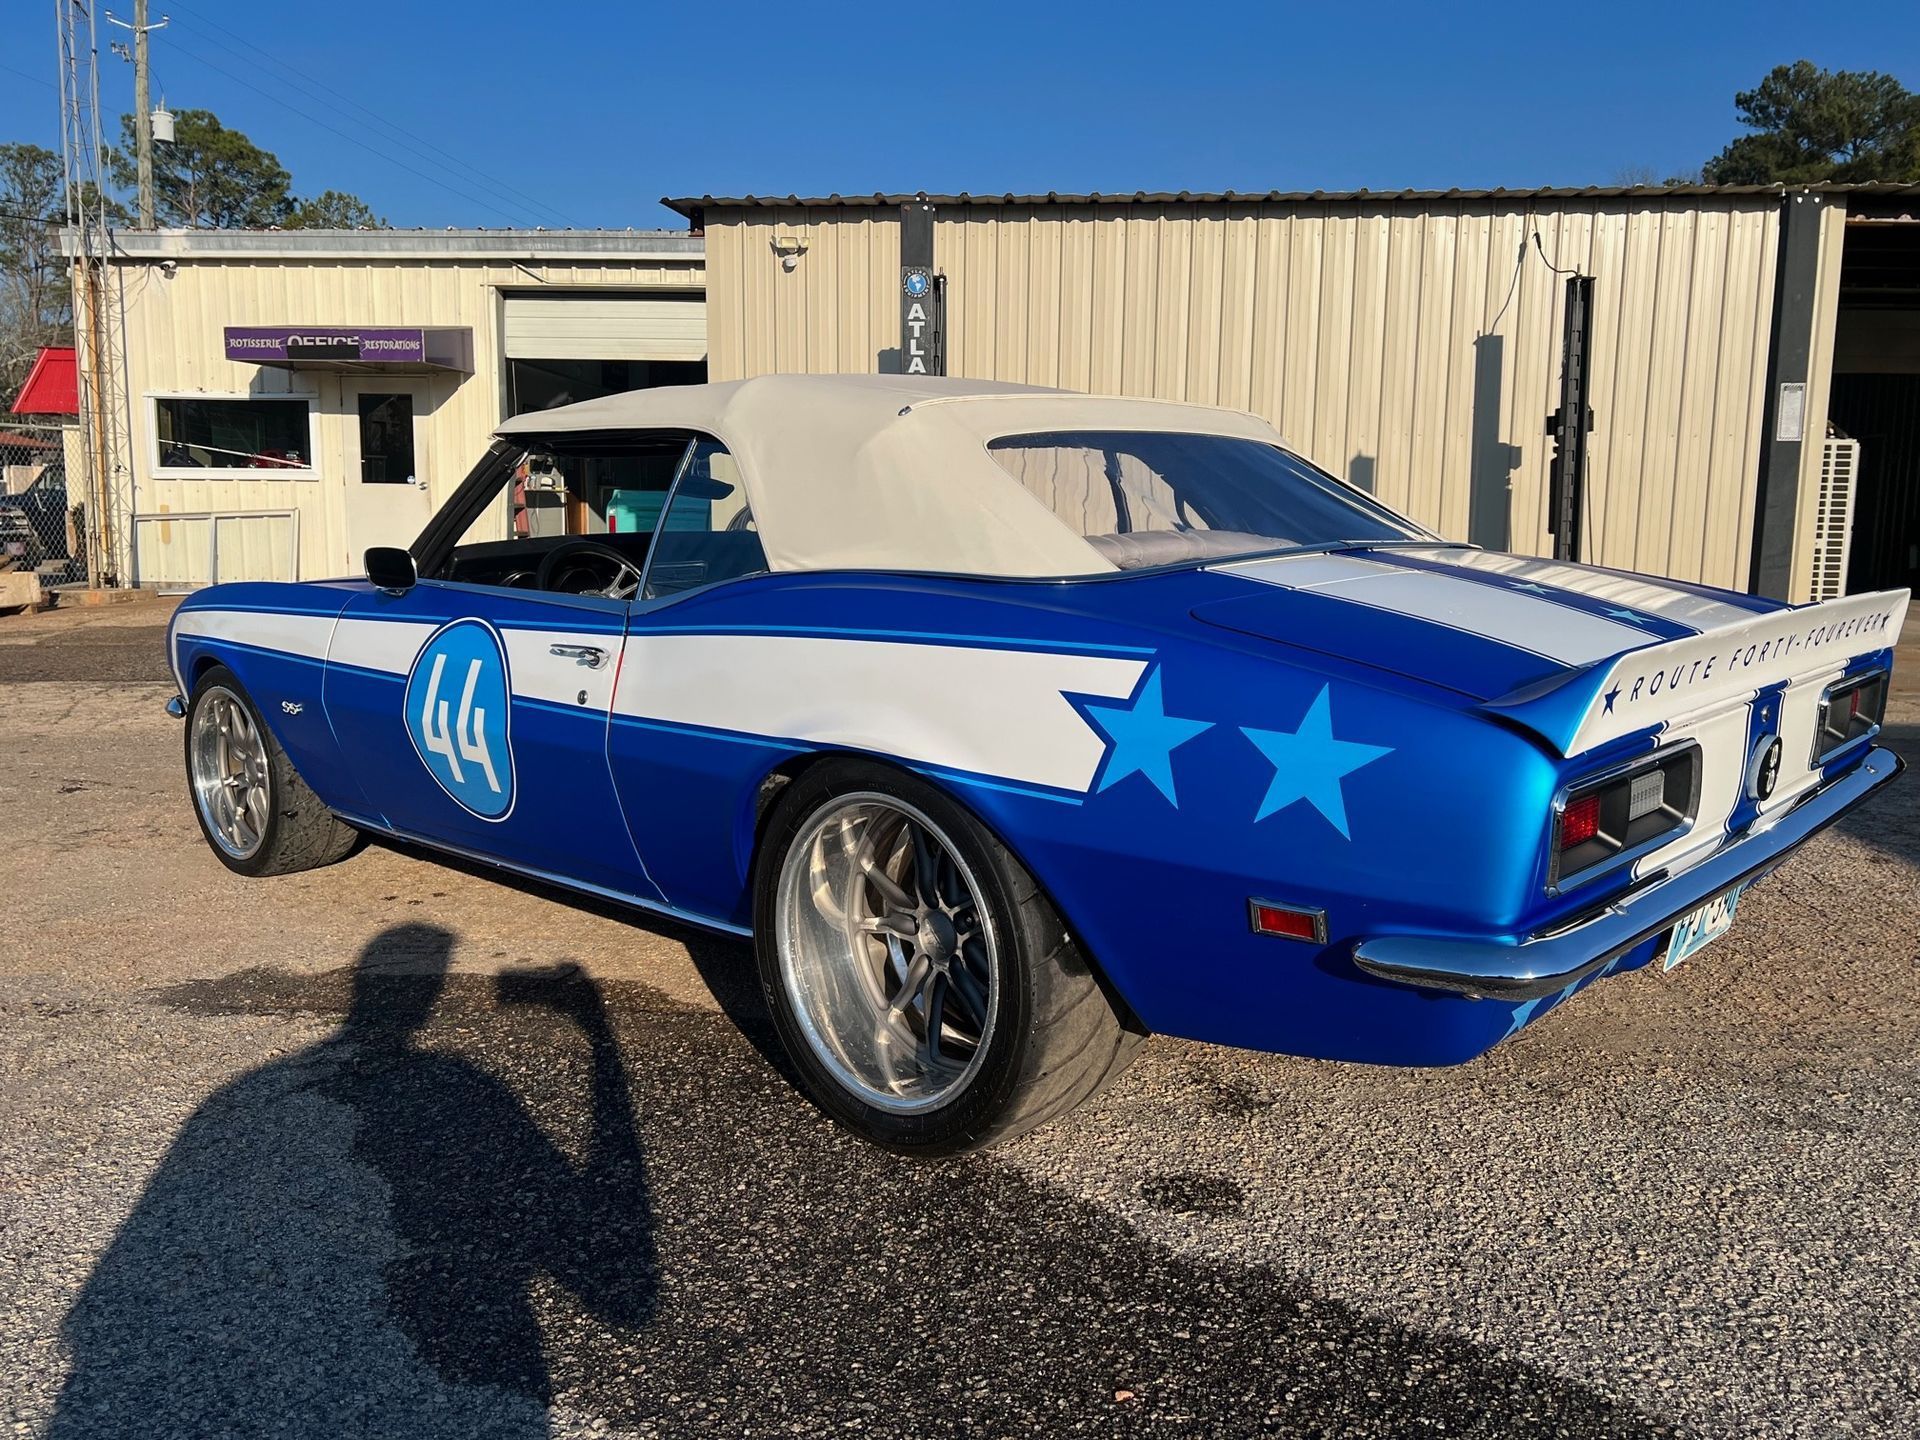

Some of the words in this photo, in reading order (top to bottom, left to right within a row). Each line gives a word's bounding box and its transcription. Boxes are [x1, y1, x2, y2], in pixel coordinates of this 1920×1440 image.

[229, 338, 281, 349] ROTISSERIE
[364, 339, 420, 351] RESTORATIONS
[907, 303, 926, 373] ATLA
[1629, 655, 1718, 702] ROUTE
[1728, 617, 1880, 672] FORTY-FOUREVER
[421, 653, 502, 794] 44
